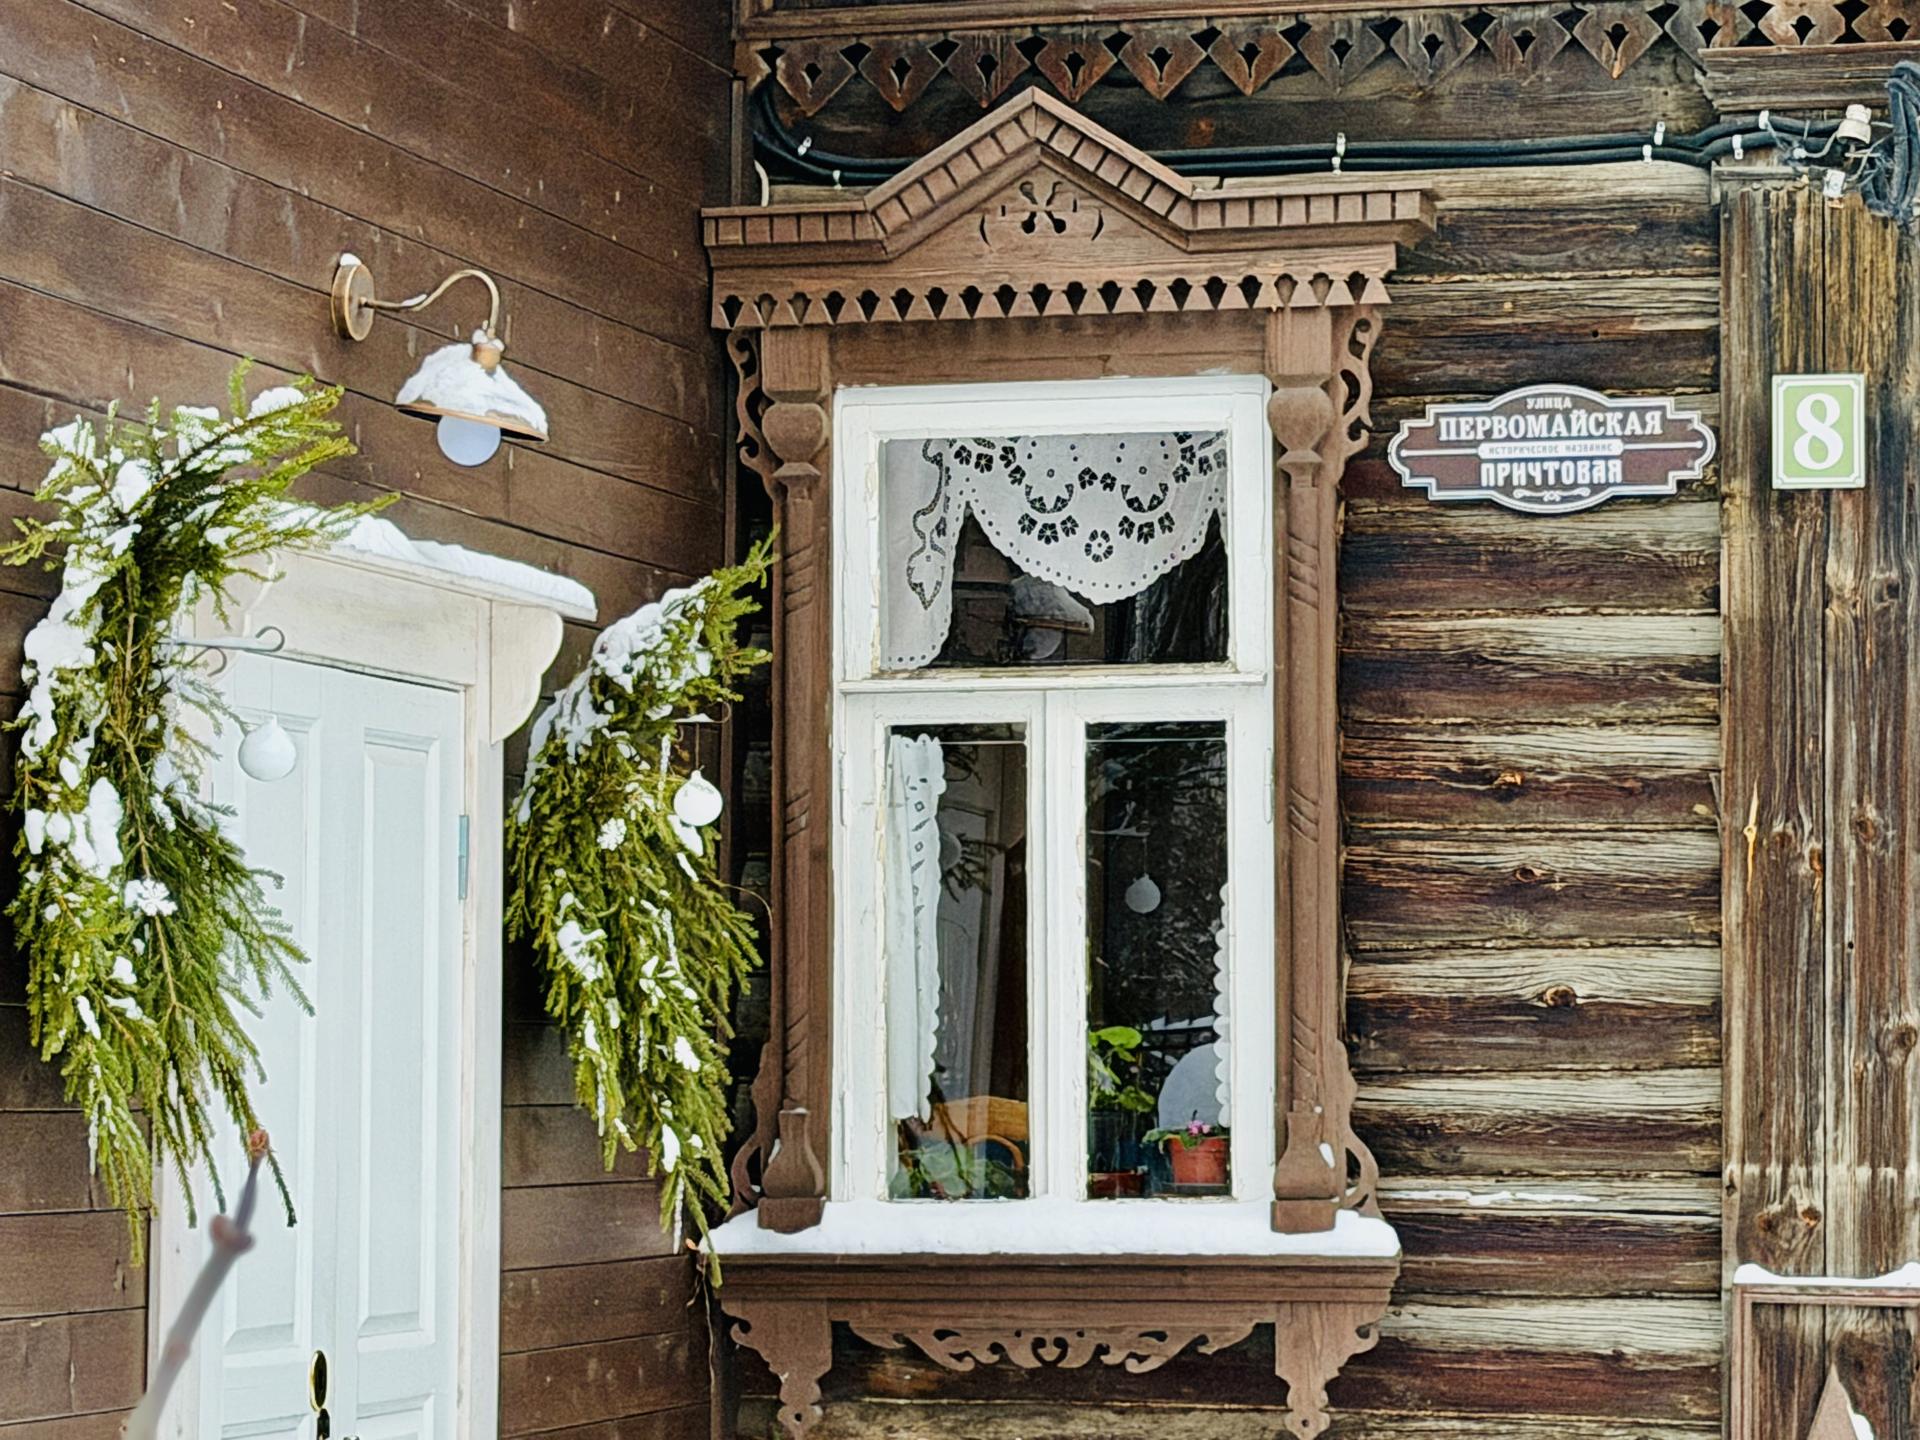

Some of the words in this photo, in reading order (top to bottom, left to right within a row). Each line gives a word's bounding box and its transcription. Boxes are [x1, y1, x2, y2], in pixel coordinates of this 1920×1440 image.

[1526, 396, 1572, 410] УЛИЦА
[1438, 411, 1664, 442] ПЕРВОМАЙСКАЯ
[1793, 393, 1844, 470] 8
[1489, 444, 1559, 455] ИСТОРИЧЕСКОЕ
[1480, 459, 1623, 487] ПРИЧТОВАЯ
